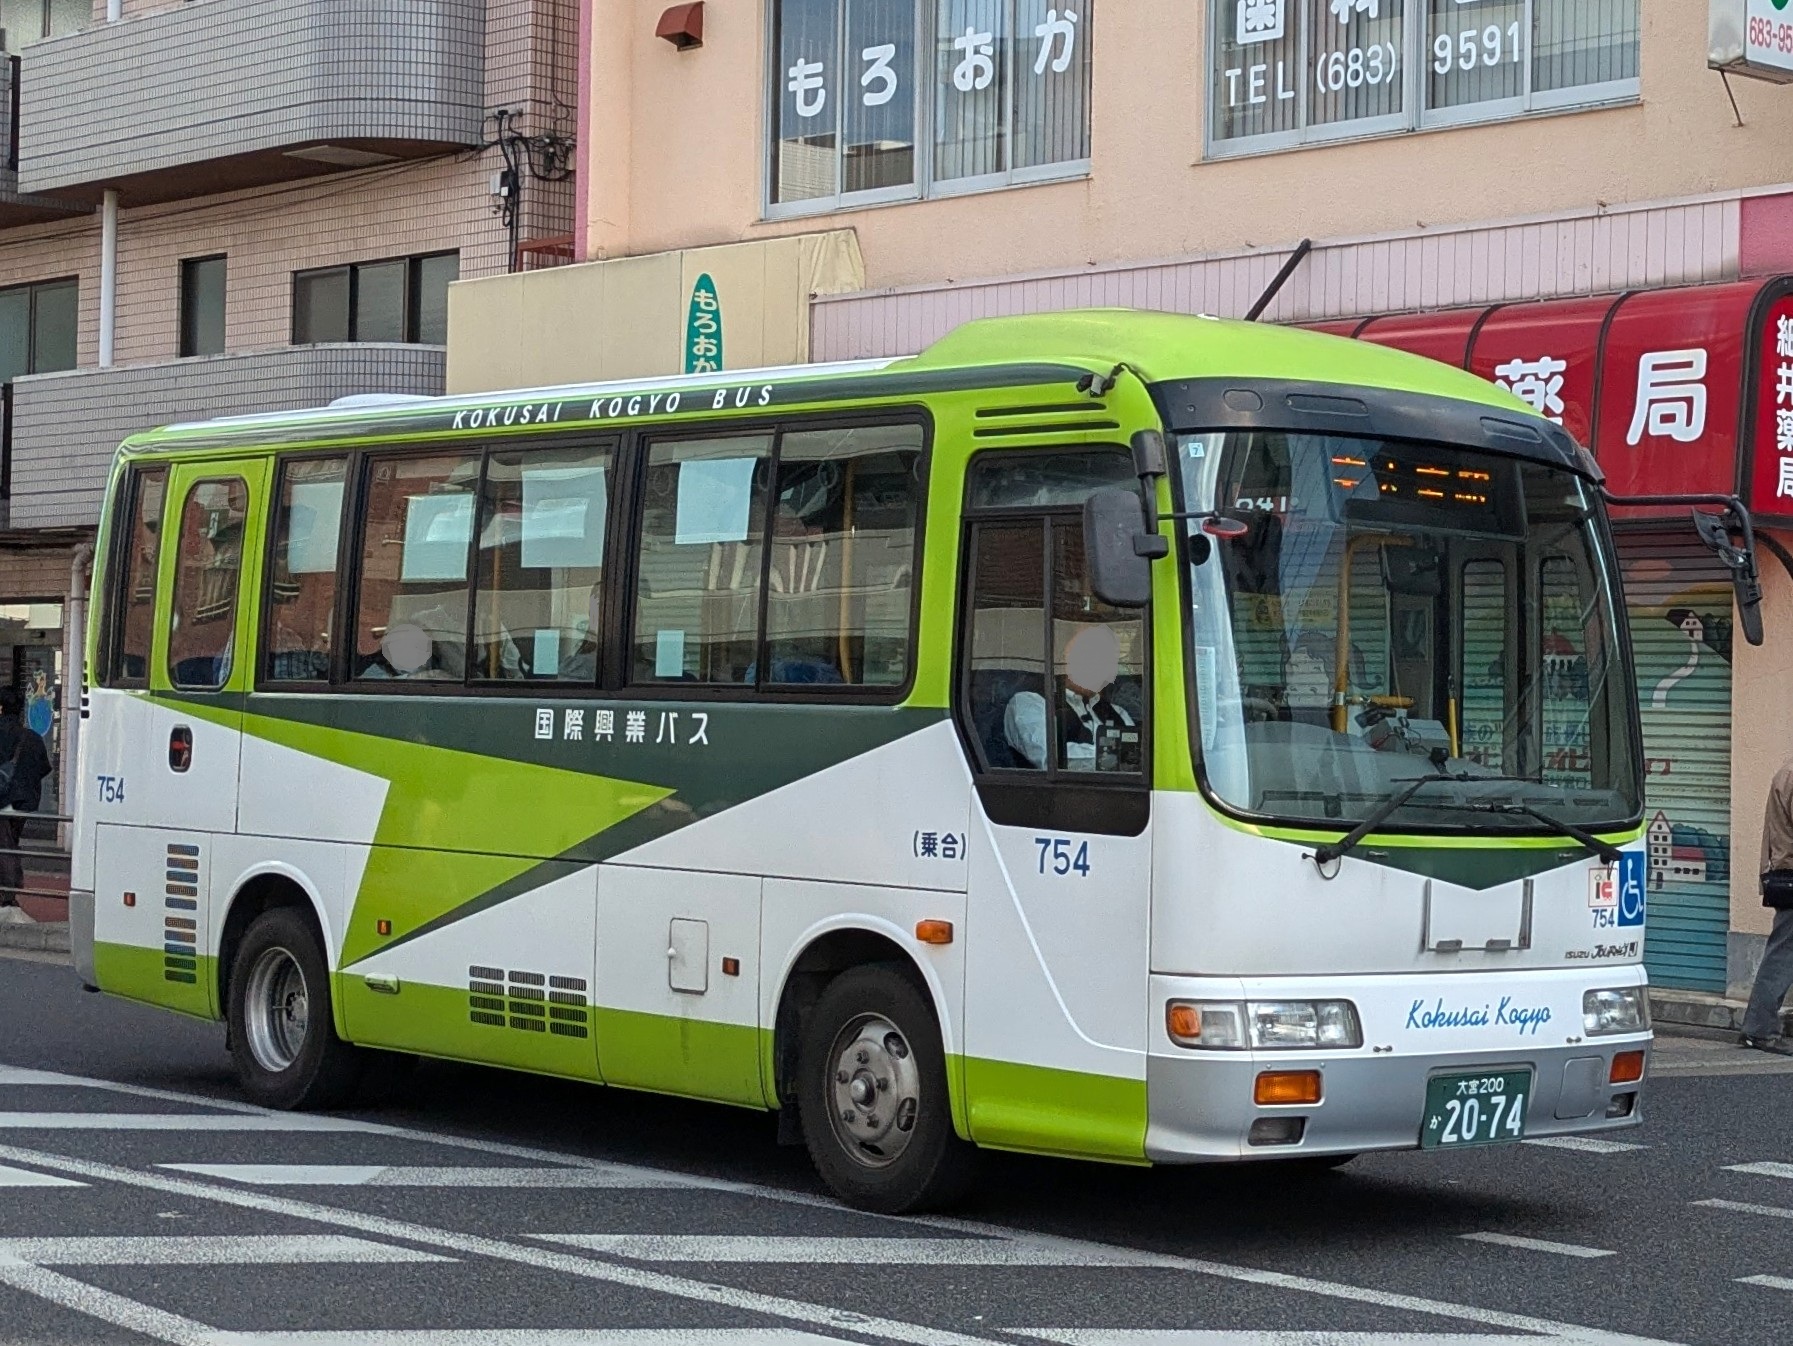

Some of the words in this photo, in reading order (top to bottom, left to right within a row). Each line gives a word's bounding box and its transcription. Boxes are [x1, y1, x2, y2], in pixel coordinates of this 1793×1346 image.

[788, 9, 1078, 117] もろおか
[1225, 61, 1295, 106] TEL
[1316, 41, 1396, 93] (683)
[1434, 21, 1519, 74] 9591
[452, 402, 562, 429] KOKUSAI
[589, 393, 680, 419] KOGYO
[712, 385, 773, 409] BUS
[534, 708, 709, 745] 国際興業バス
[97, 776, 125, 803] 754
[913, 830, 967, 861] (乗合)
[1035, 837, 1091, 877] 754
[1592, 908, 1615, 928] 754
[1405, 998, 1489, 1029] Kokusai
[1495, 996, 1551, 1035] Kogyo
[1441, 1093, 1523, 1143] 20-74
